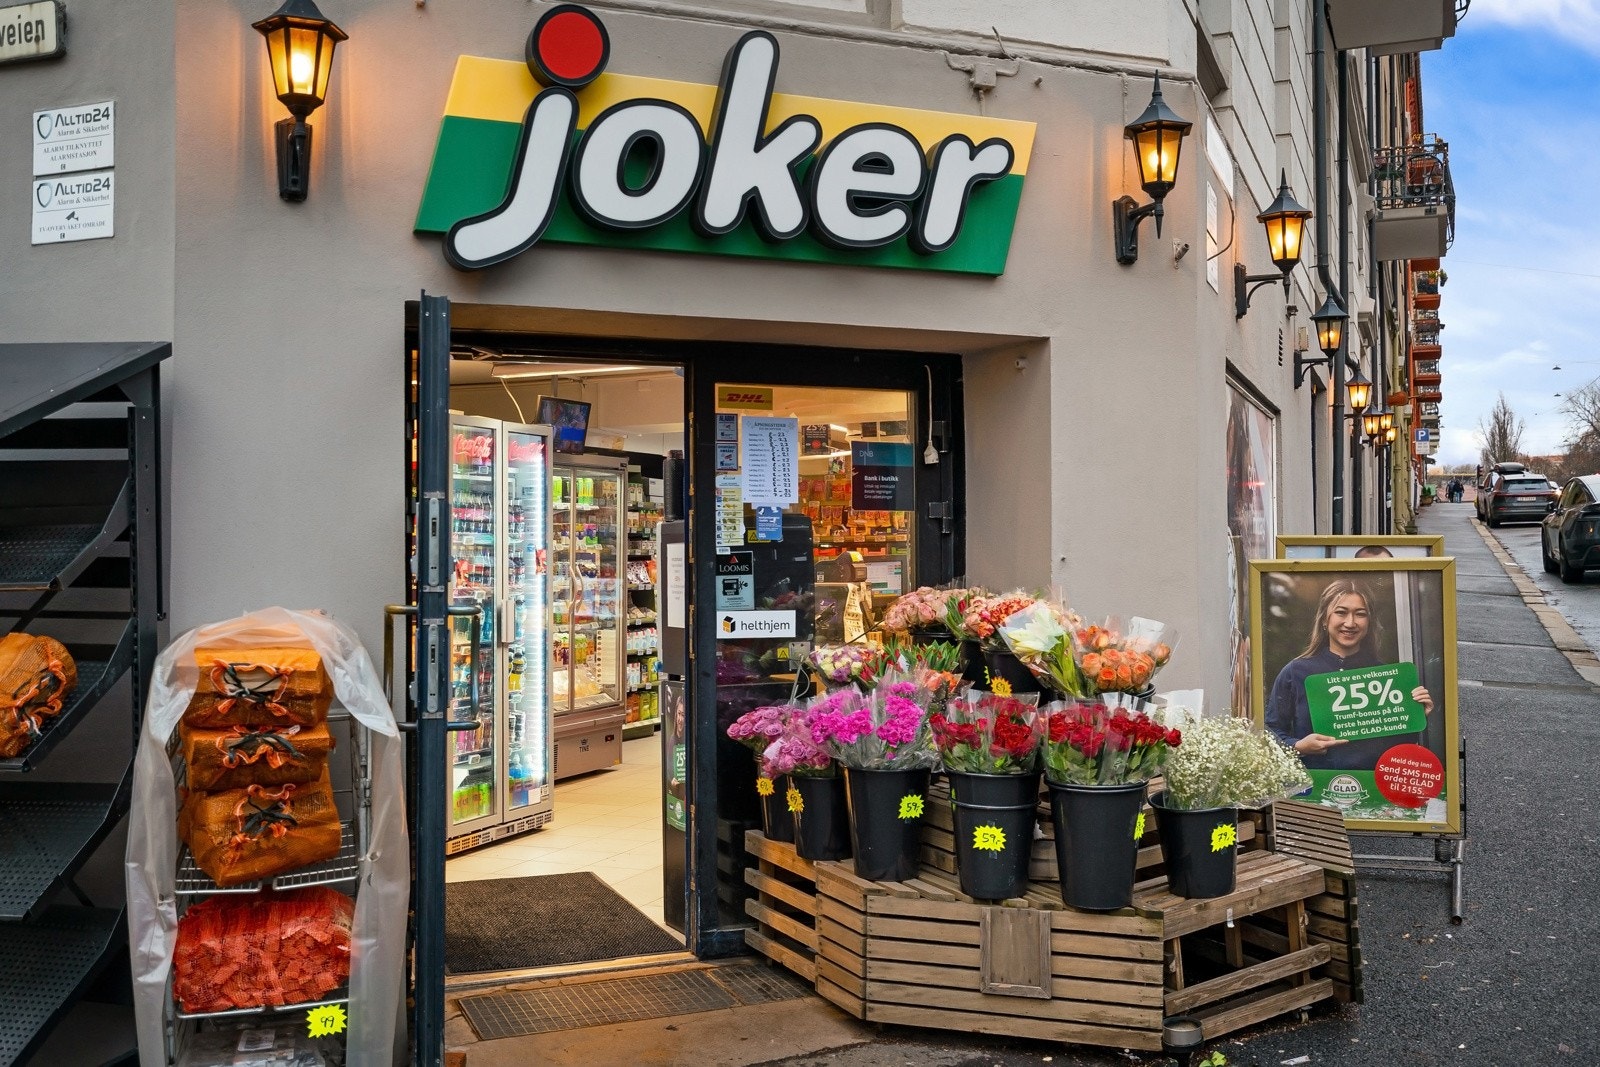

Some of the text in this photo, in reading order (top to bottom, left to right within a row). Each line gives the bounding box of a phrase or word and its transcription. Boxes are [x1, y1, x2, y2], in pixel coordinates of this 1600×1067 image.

[55, 107, 110, 128] ALLTID24
[83, 124, 109, 133] Sikkerhet
[442, 4, 1014, 272] joker
[66, 141, 102, 150] TILKNYTTET
[51, 150, 97, 161] ALARMSTASJON
[55, 177, 110, 196] ALLTID24
[726, 393, 764, 403] DHL
[1419, 431, 1426, 440] P
[741, 620, 790, 633] helthjem
[1362, 668, 1398, 679] velkomst!
[1328, 678, 1403, 712] 25%
[1334, 709, 1380, 721] Trumf-bonus
[1382, 707, 1391, 716] på
[1357, 718, 1382, 726] handel
[1339, 723, 1406, 737] Joker GLAD-kunde
[1379, 764, 1441, 780] Send SMS med
[1384, 774, 1434, 788] ordet GLAD
